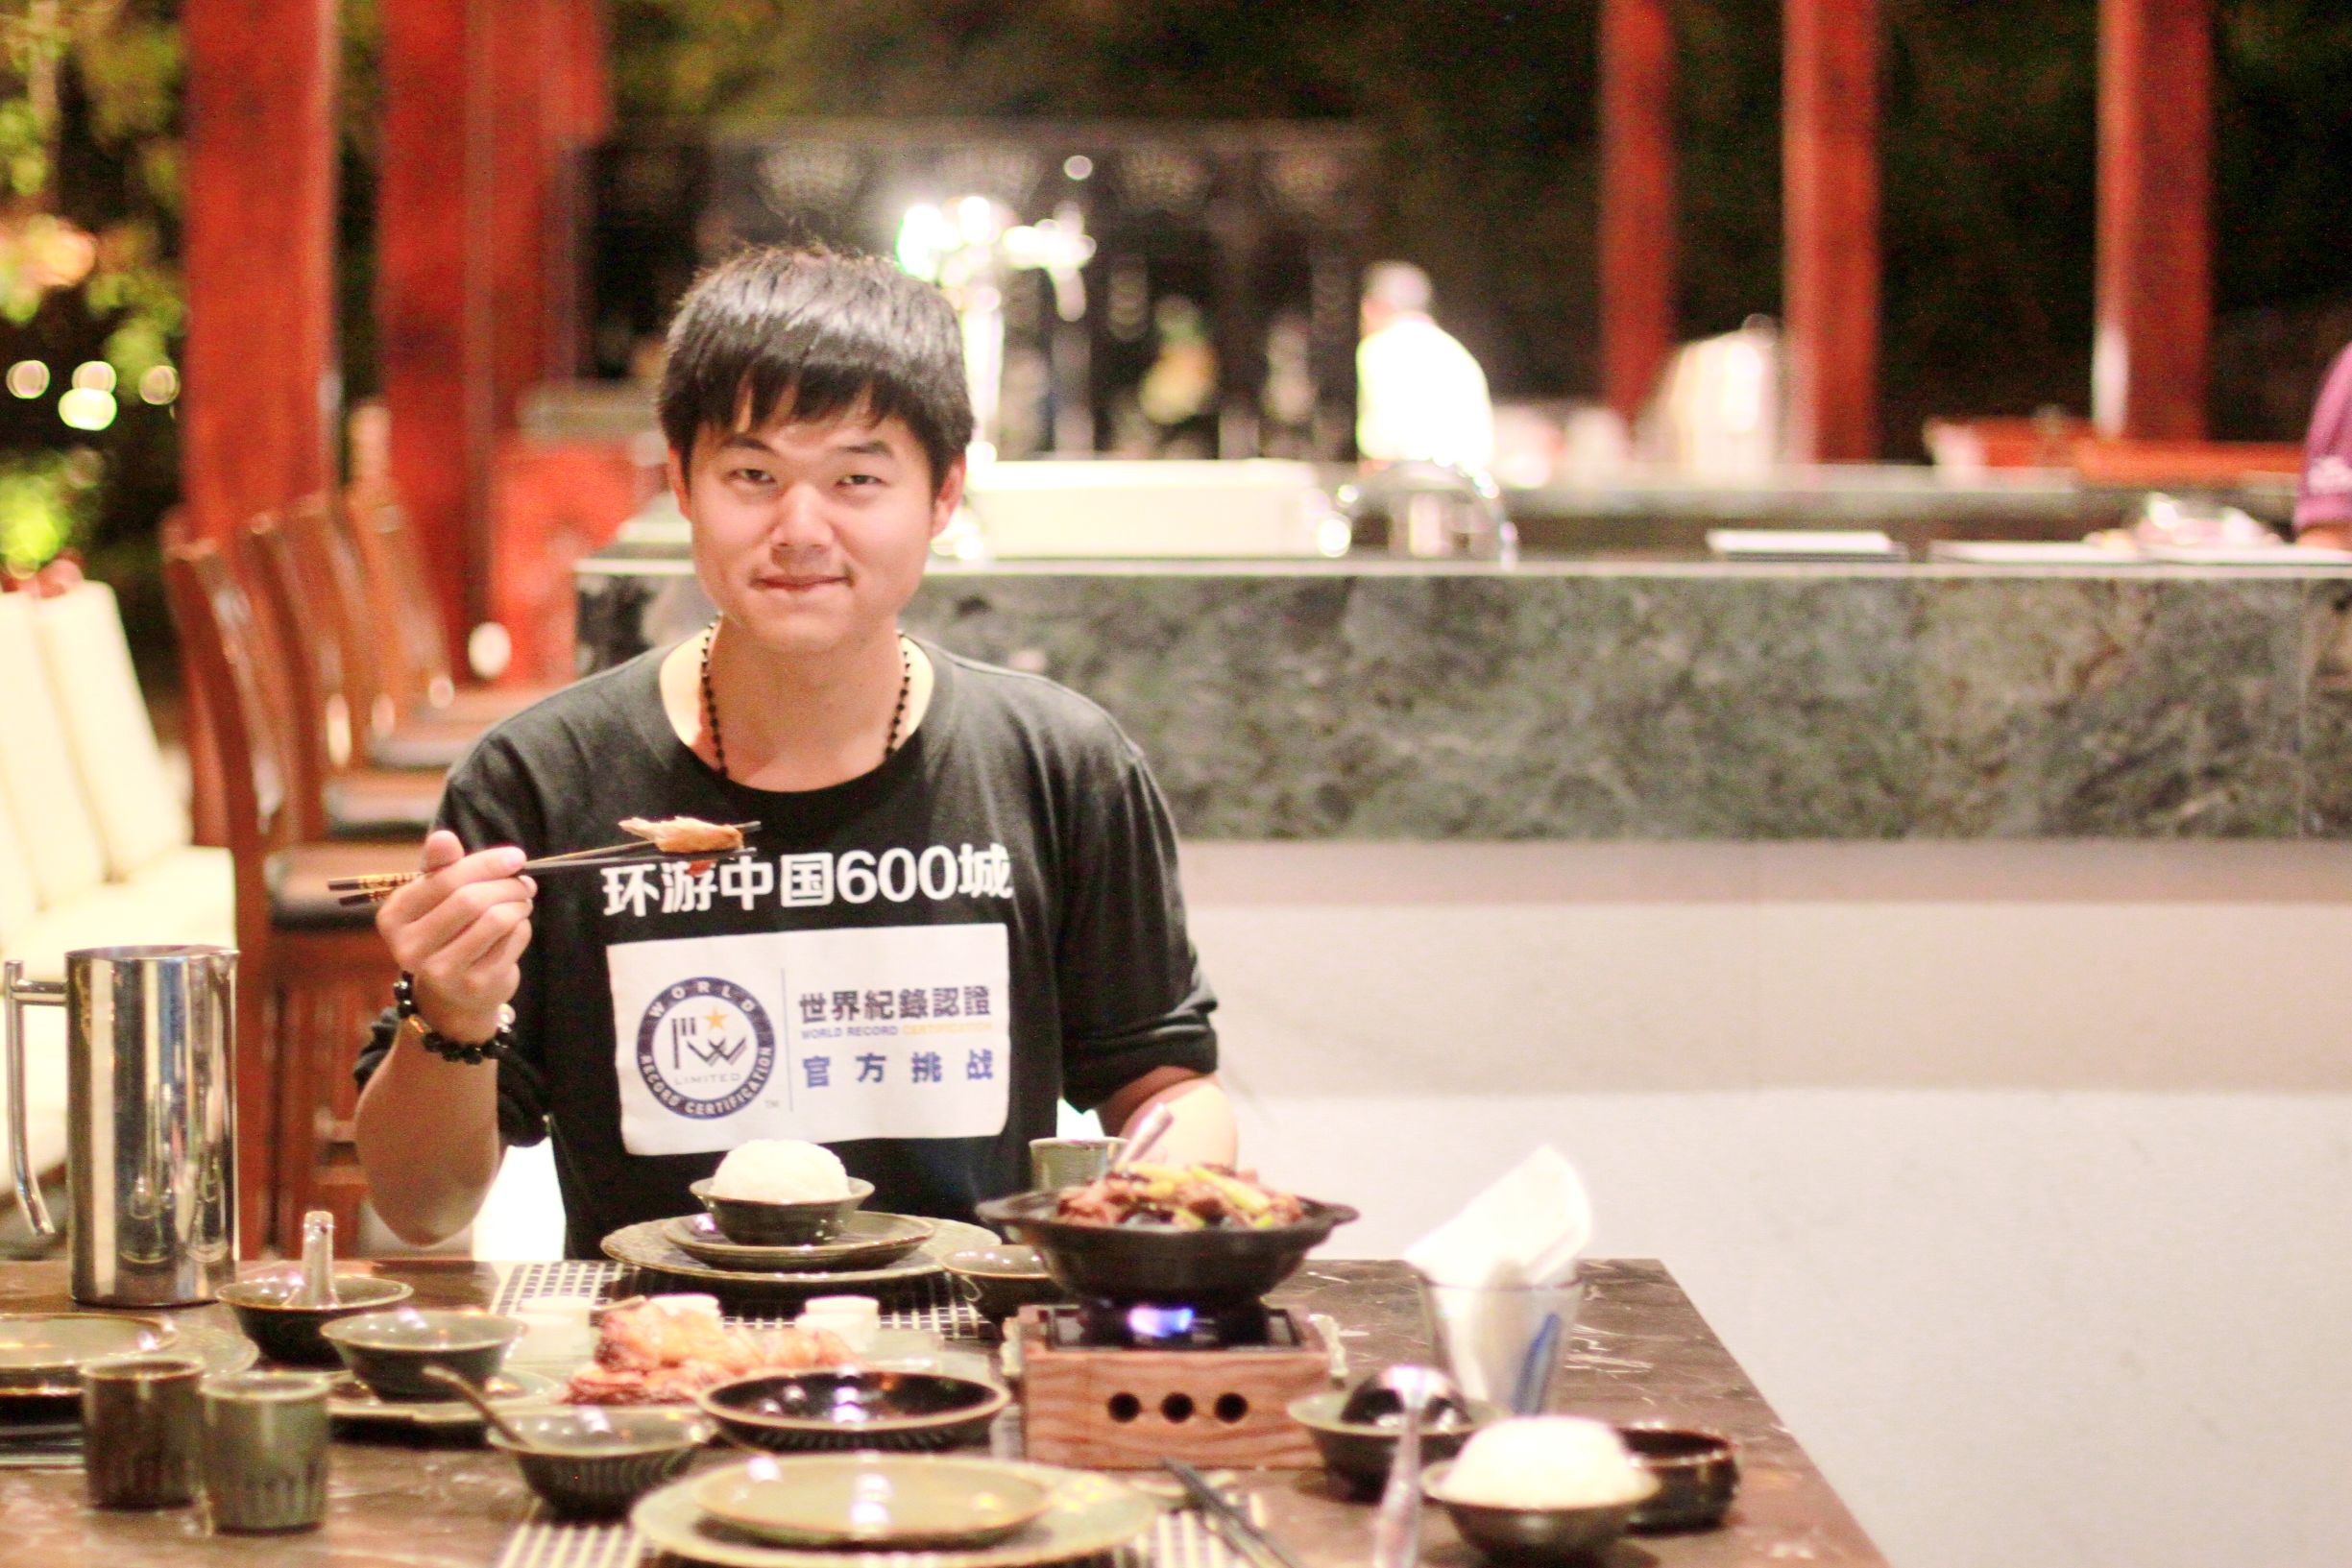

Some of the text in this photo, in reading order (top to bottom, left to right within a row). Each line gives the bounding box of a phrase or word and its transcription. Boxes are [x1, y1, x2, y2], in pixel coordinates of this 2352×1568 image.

[600, 843, 1014, 917] 环游中国600城
[649, 980, 756, 1018] WORLD
[801, 1027, 842, 1039] WORLD
[847, 1025, 898, 1036] RECORD
[641, 1047, 772, 1115] RECORD CERTIFICATION
[674, 1073, 741, 1085] LIMITED
[803, 1049, 994, 1088] 官方挑战
